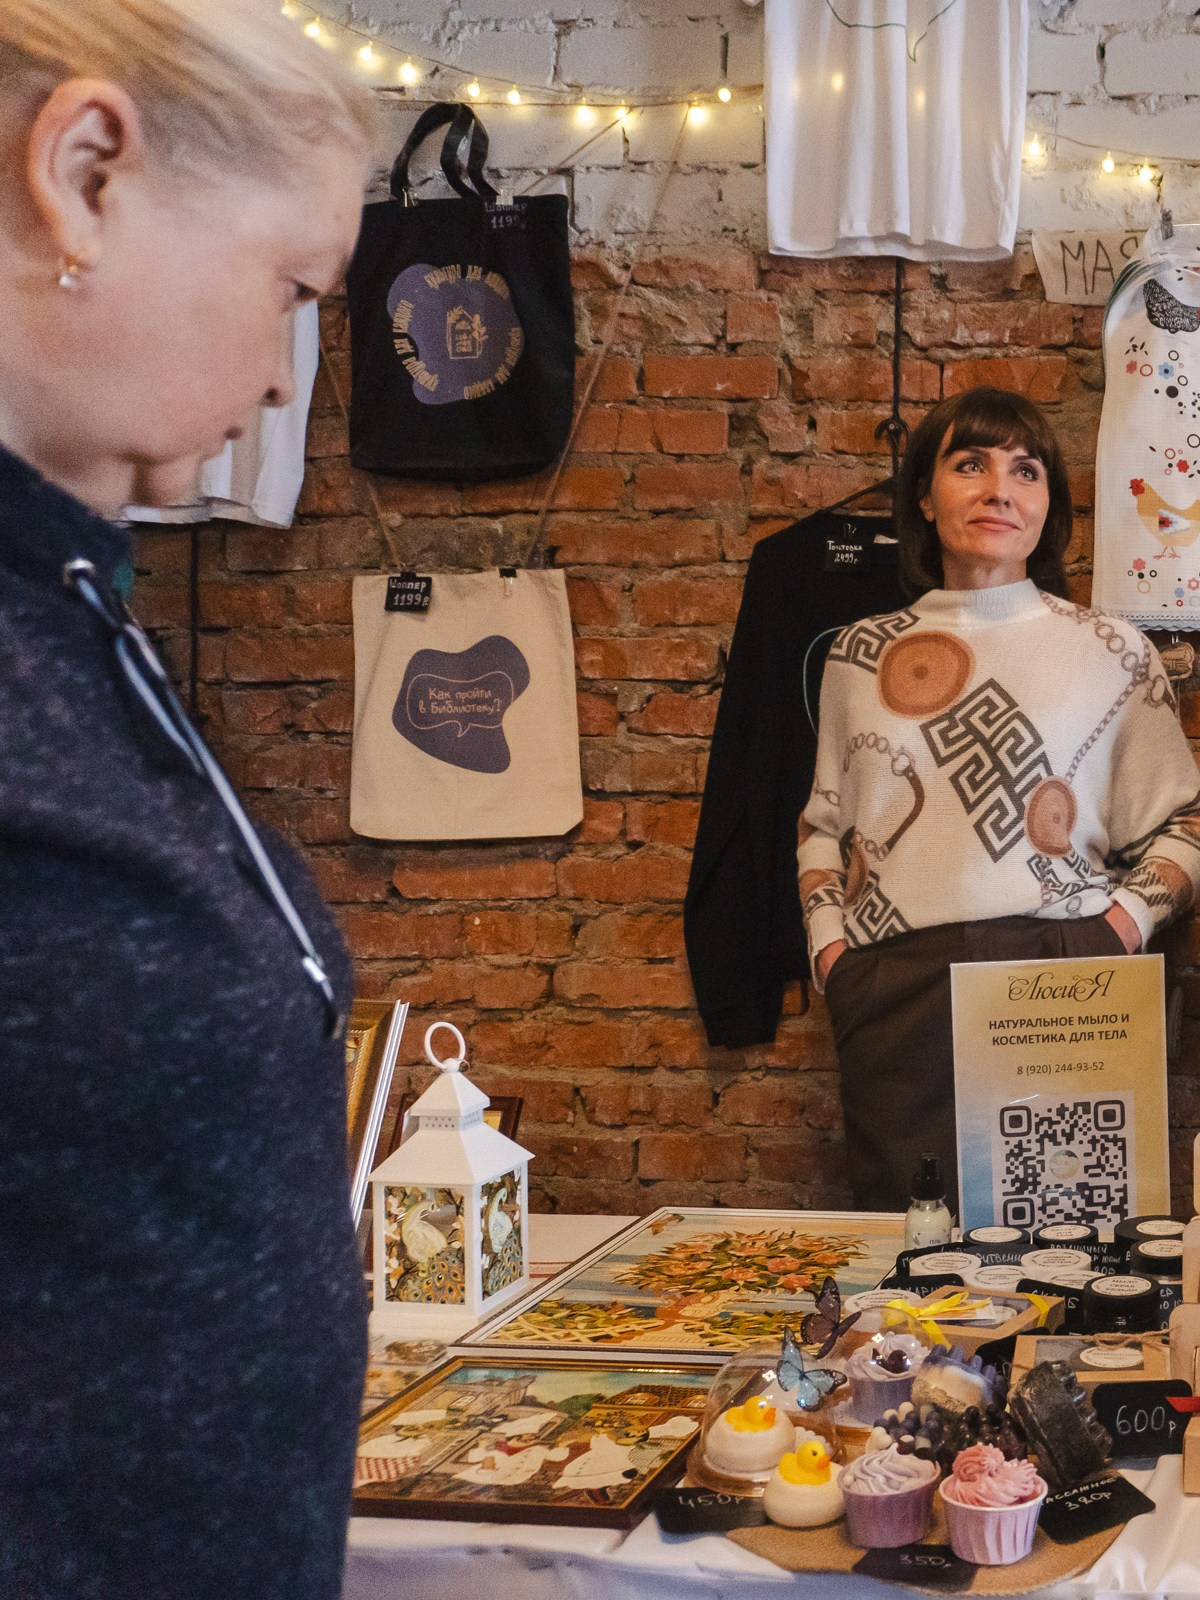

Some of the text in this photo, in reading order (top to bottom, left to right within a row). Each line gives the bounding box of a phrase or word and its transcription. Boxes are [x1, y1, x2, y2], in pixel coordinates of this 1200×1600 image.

[428, 687, 492, 703] Как пройти
[418, 699, 426, 714] в
[988, 1013, 1130, 1030] НАТУРАЛЬНОЕ МЫЛО И
[992, 1029, 1128, 1046] КОСМЕТИКА ДЛЯ ТЕЛА
[1016, 1061, 1105, 1076] 8 (920) 244-93-52
